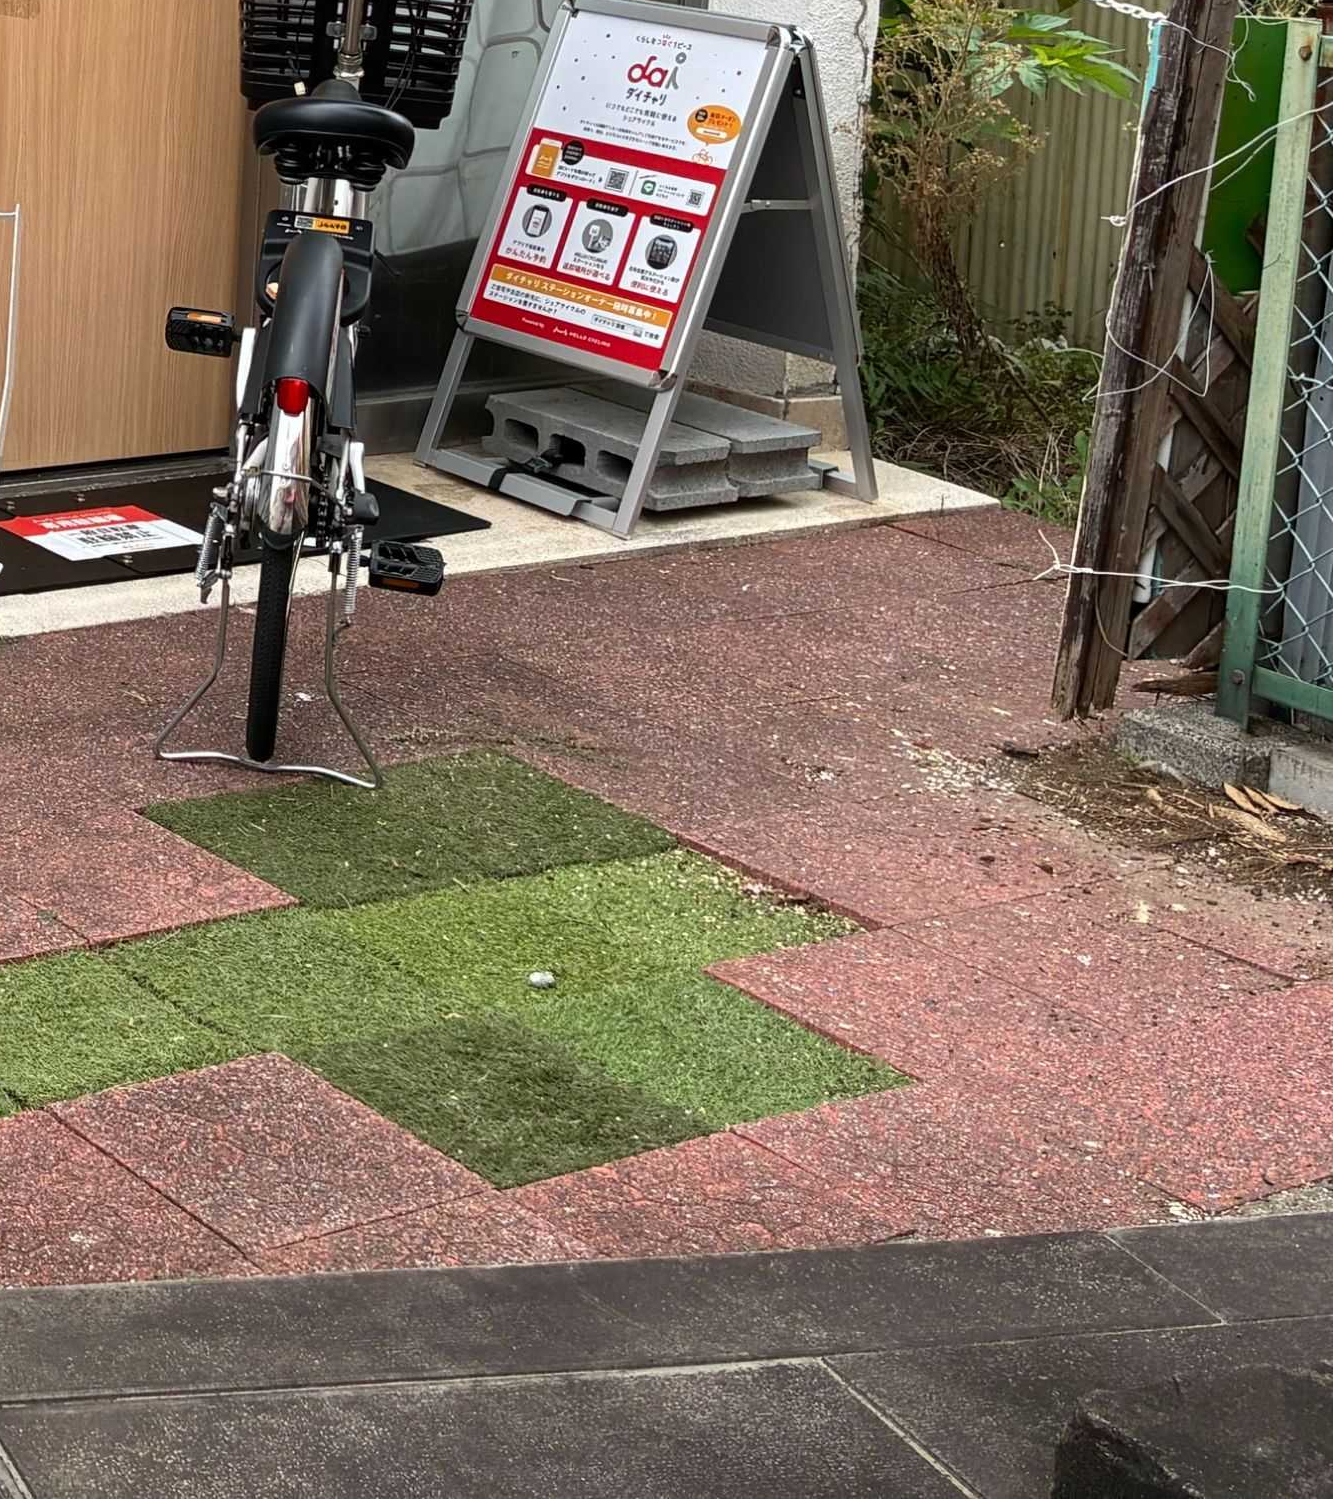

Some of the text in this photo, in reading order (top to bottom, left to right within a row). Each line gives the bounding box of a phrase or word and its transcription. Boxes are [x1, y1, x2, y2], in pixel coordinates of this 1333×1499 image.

[627, 52, 687, 90] dai
[625, 87, 668, 107] ダイチャリ
